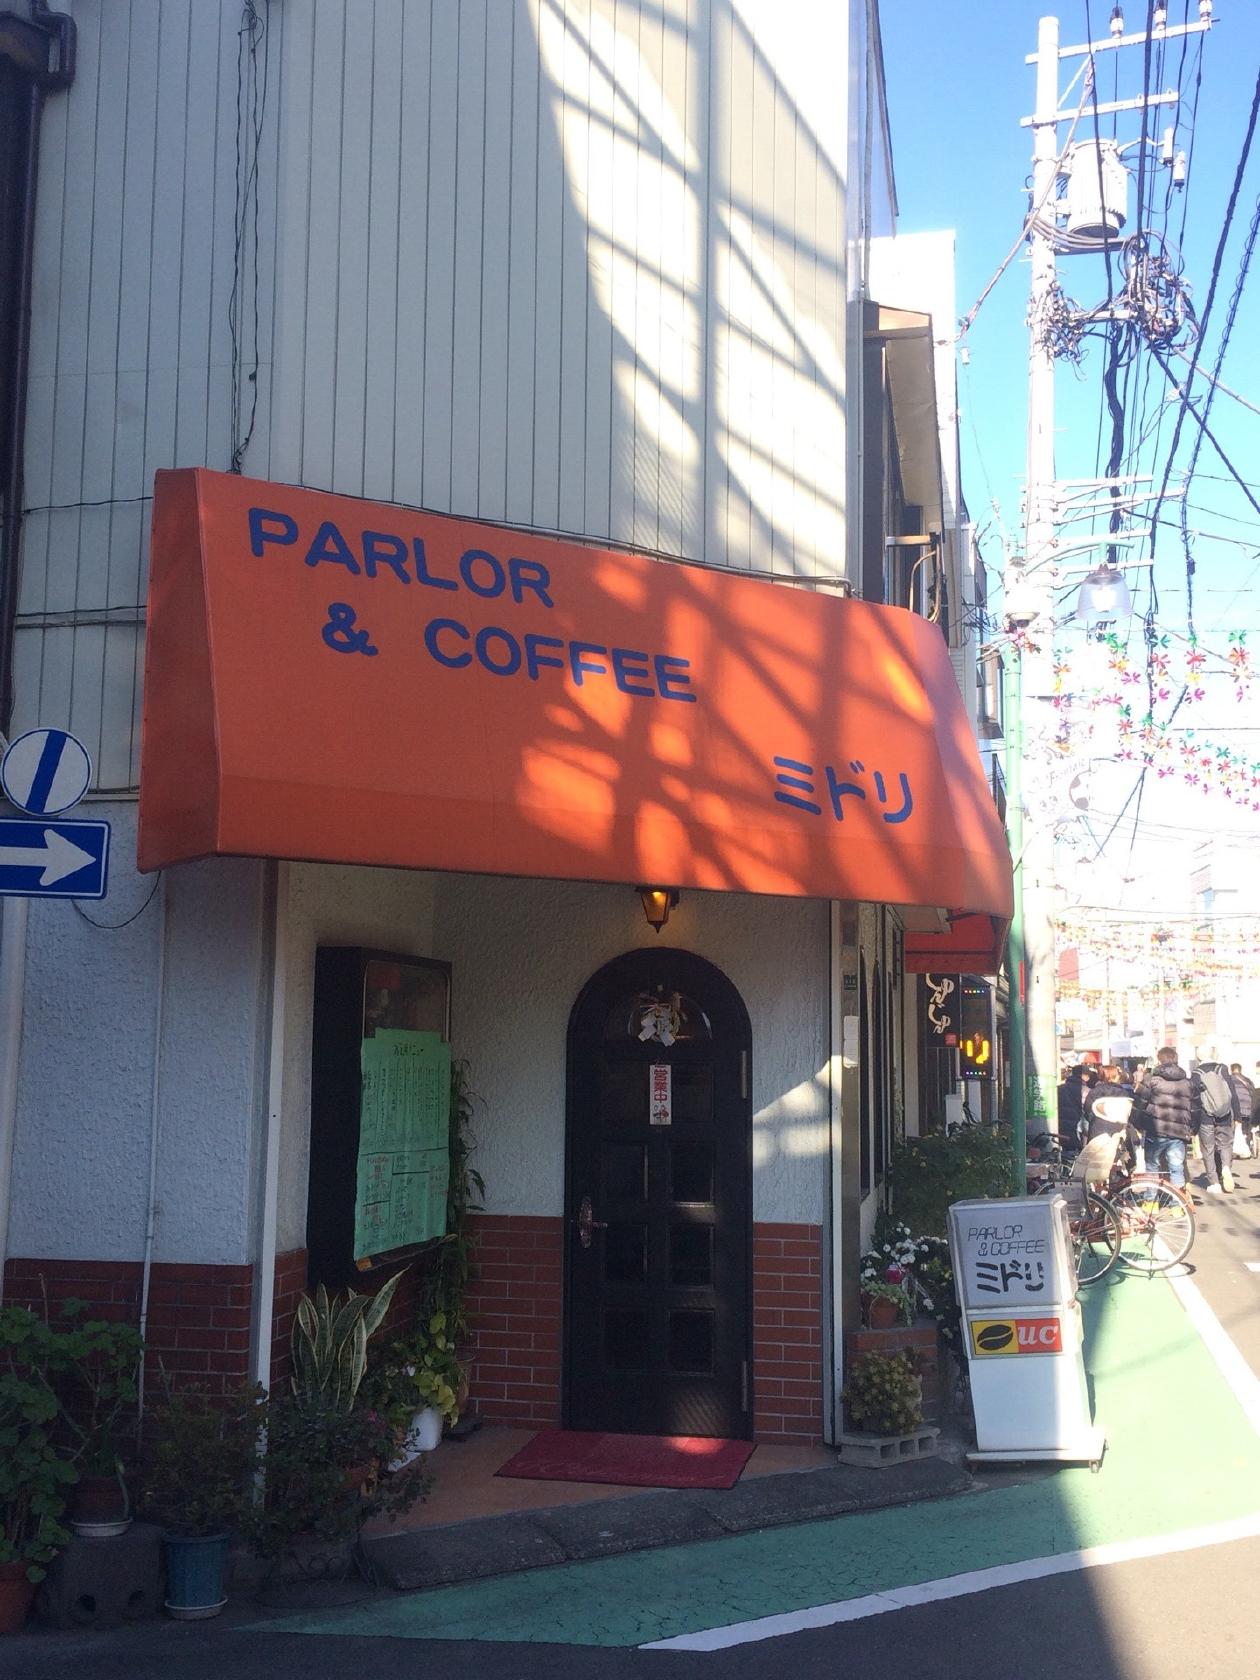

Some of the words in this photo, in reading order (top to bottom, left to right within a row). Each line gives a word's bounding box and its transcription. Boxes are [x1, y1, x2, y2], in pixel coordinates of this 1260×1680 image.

[249, 507, 553, 608] PARLOR
[321, 602, 378, 656] &
[424, 618, 697, 702] COFFEE
[774, 756, 913, 823] ミドリ
[654, 1069, 668, 1103] 営業中
[968, 1225, 1023, 1241] PARLOR
[978, 1242, 987, 1256] &
[991, 1240, 1046, 1256] COFFEE
[976, 1260, 1045, 1294] ミドリ
